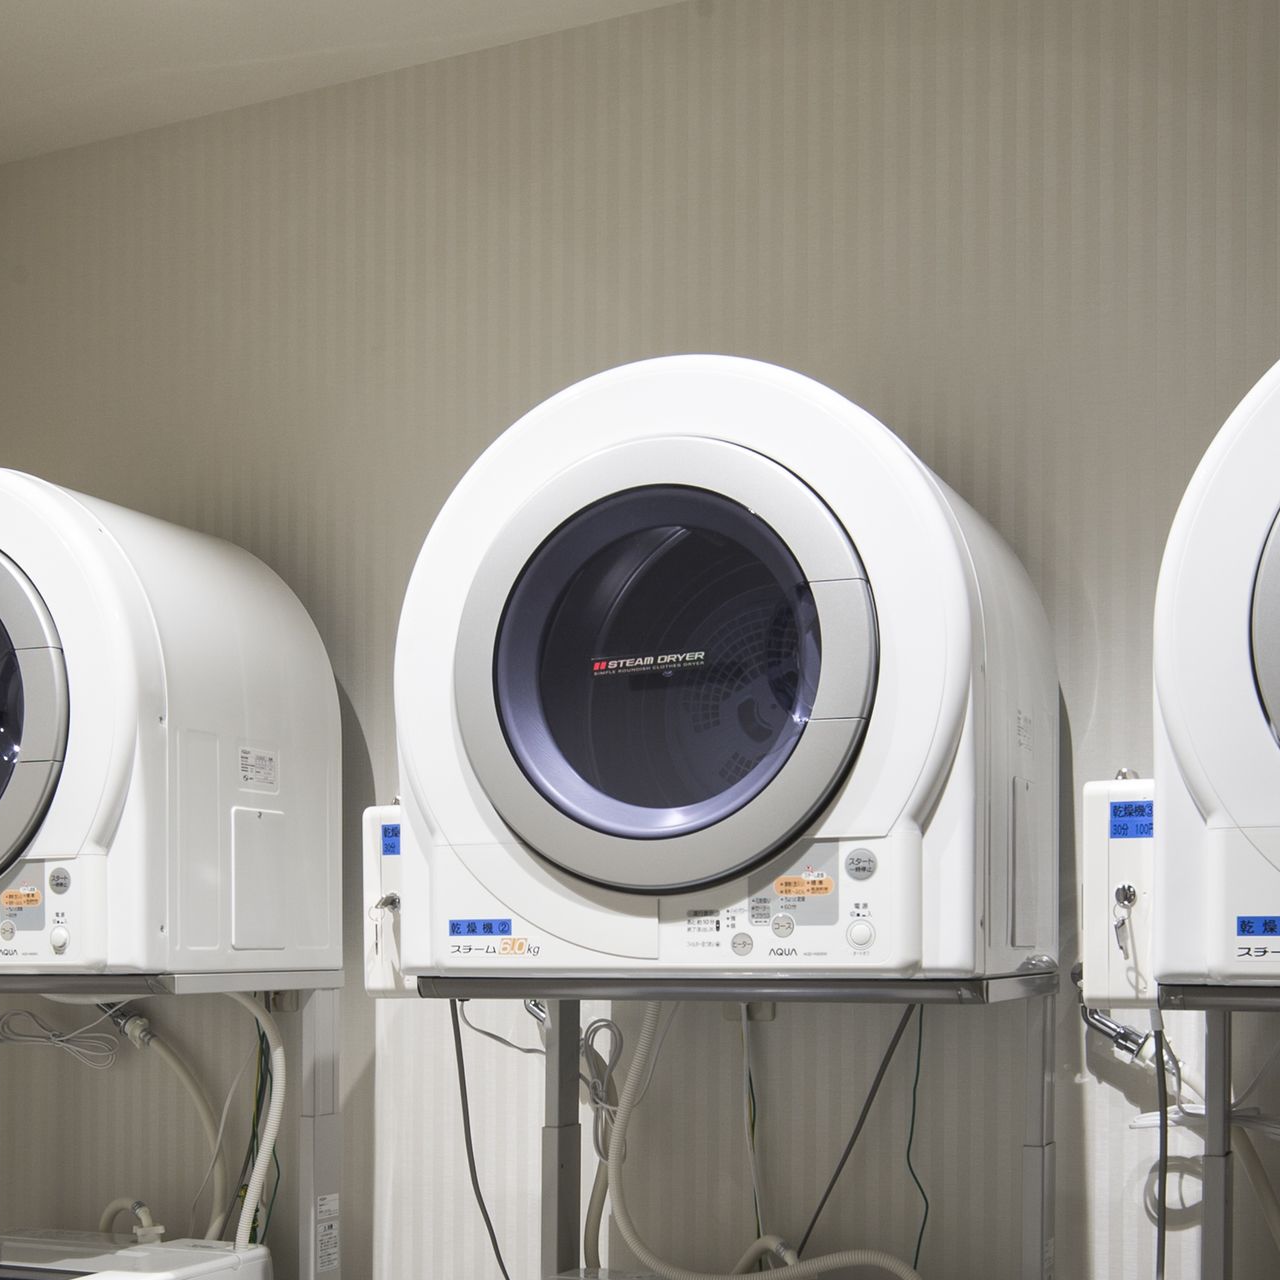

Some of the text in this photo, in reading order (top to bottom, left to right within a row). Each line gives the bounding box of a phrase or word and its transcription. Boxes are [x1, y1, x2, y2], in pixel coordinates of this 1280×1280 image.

[608, 651, 705, 669] STEAM DRYER
[849, 857, 874, 866] スタート
[451, 922, 510, 934] 乾燥機②
[774, 922, 792, 930] コース
[0, 948, 18, 956] AQUA
[769, 948, 798, 956] AQUA
